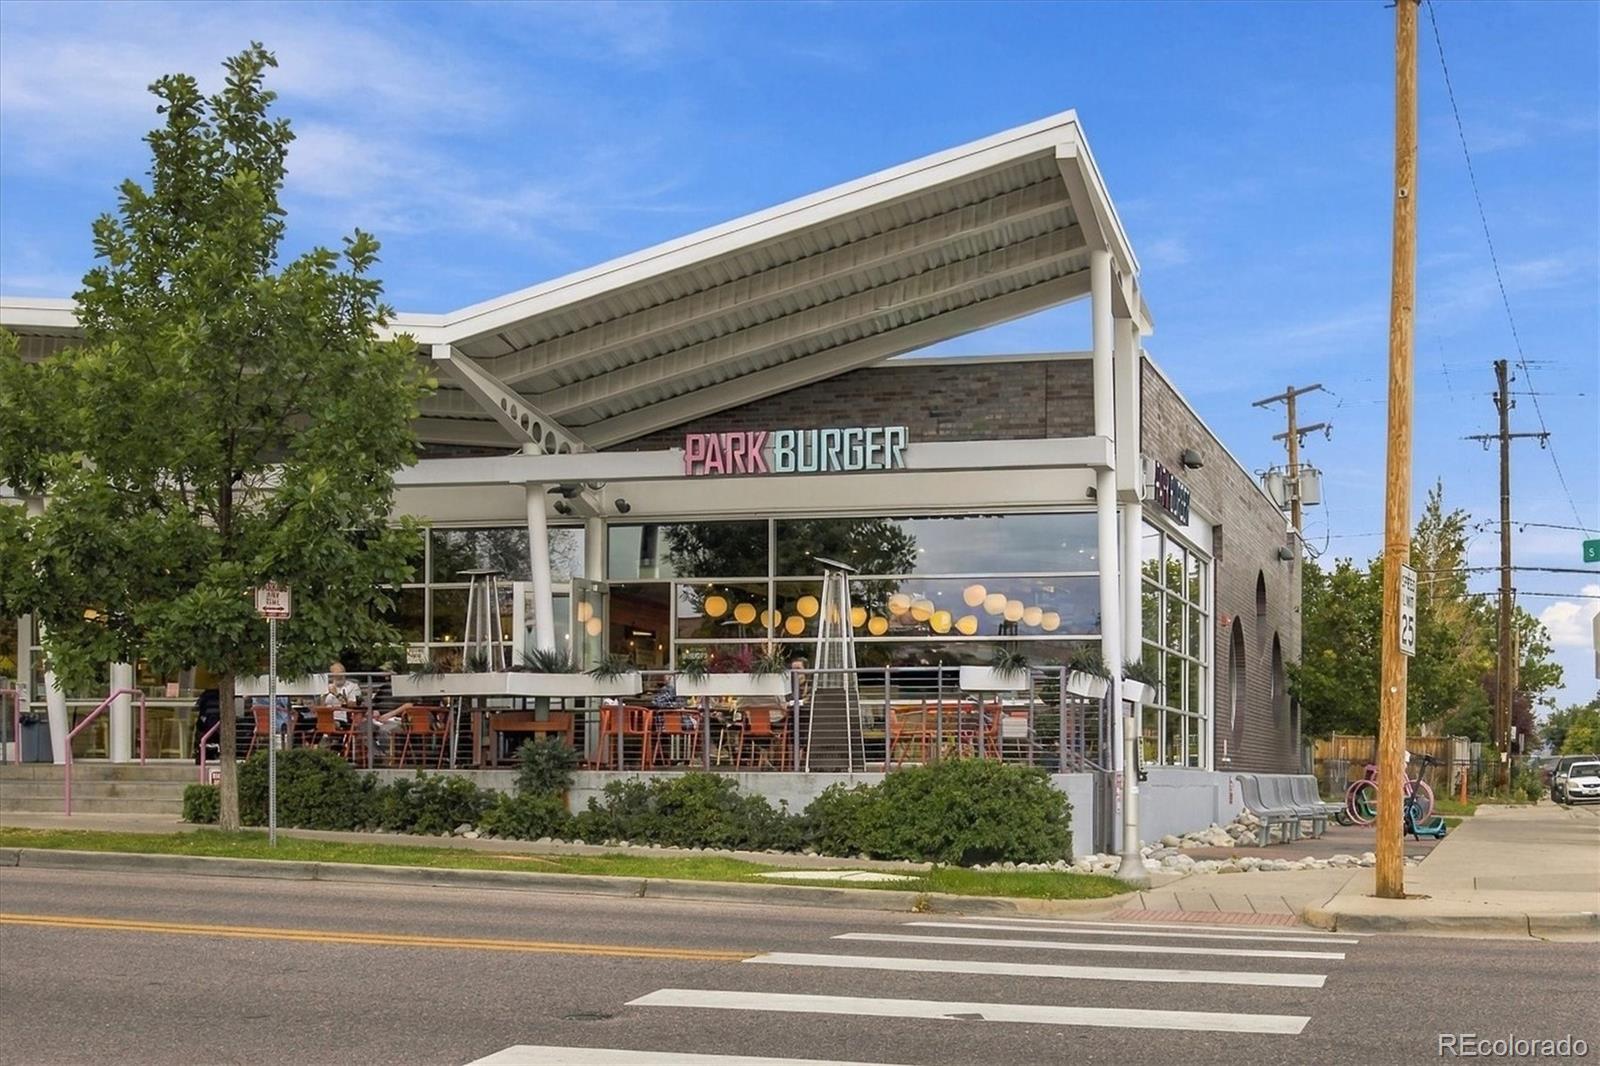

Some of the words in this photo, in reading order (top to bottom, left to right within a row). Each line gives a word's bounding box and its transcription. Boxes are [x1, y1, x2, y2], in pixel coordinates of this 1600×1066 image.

[685, 431, 769, 475] PARK
[774, 426, 909, 473] BURGER
[1588, 547, 1595, 557] S
[1401, 613, 1414, 647] 25
